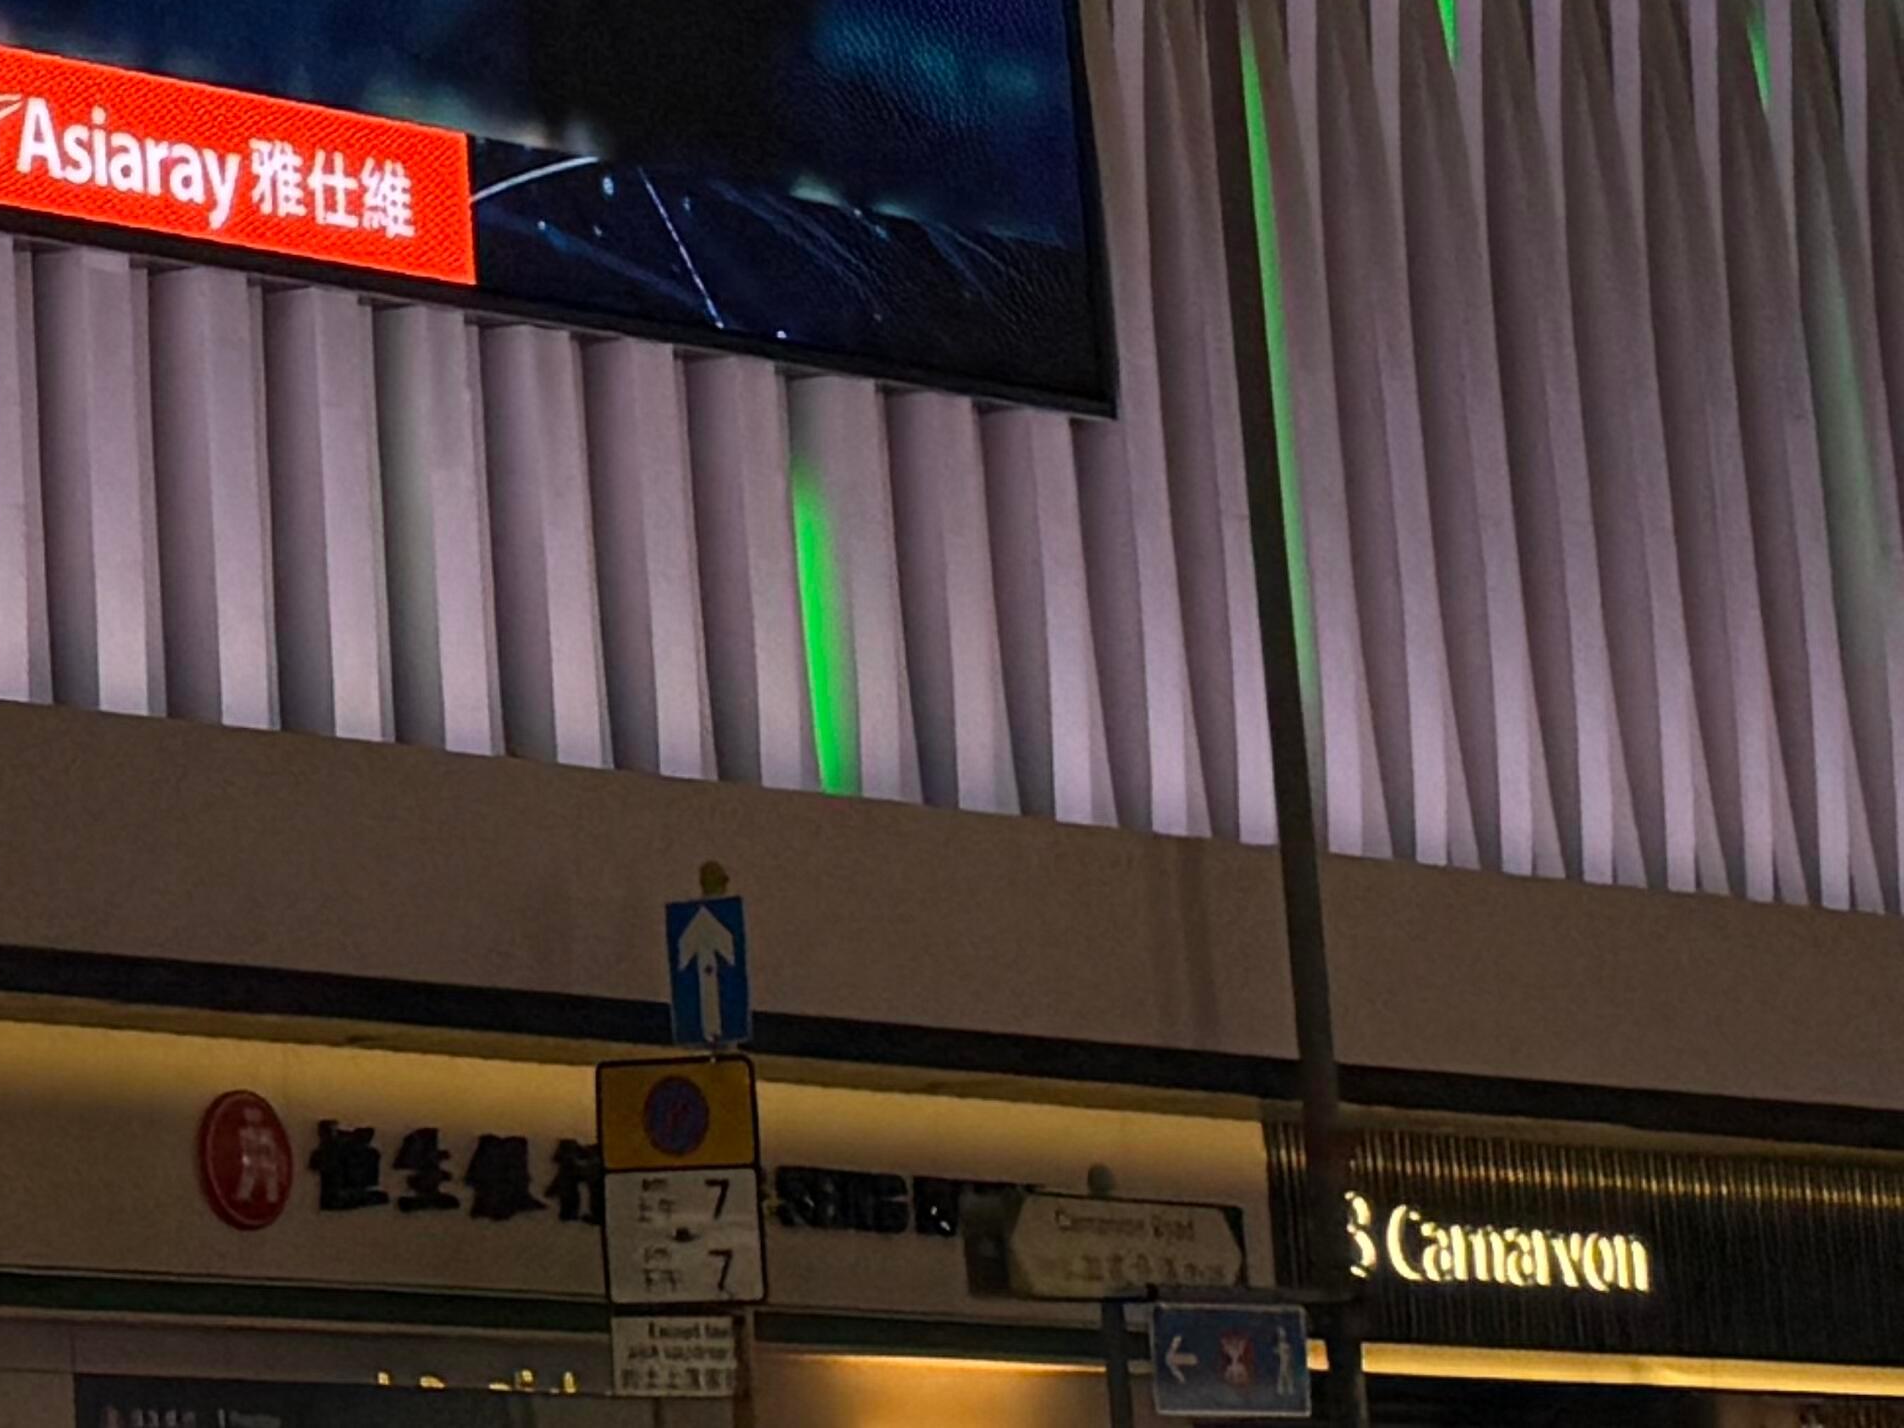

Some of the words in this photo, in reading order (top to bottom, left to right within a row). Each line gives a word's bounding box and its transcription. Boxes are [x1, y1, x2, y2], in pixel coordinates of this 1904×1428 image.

[16, 97, 241, 230] Asiaray
[249, 136, 416, 238] 雅仕維
[704, 1179, 730, 1220] 7
[708, 1249, 733, 1292] 7
